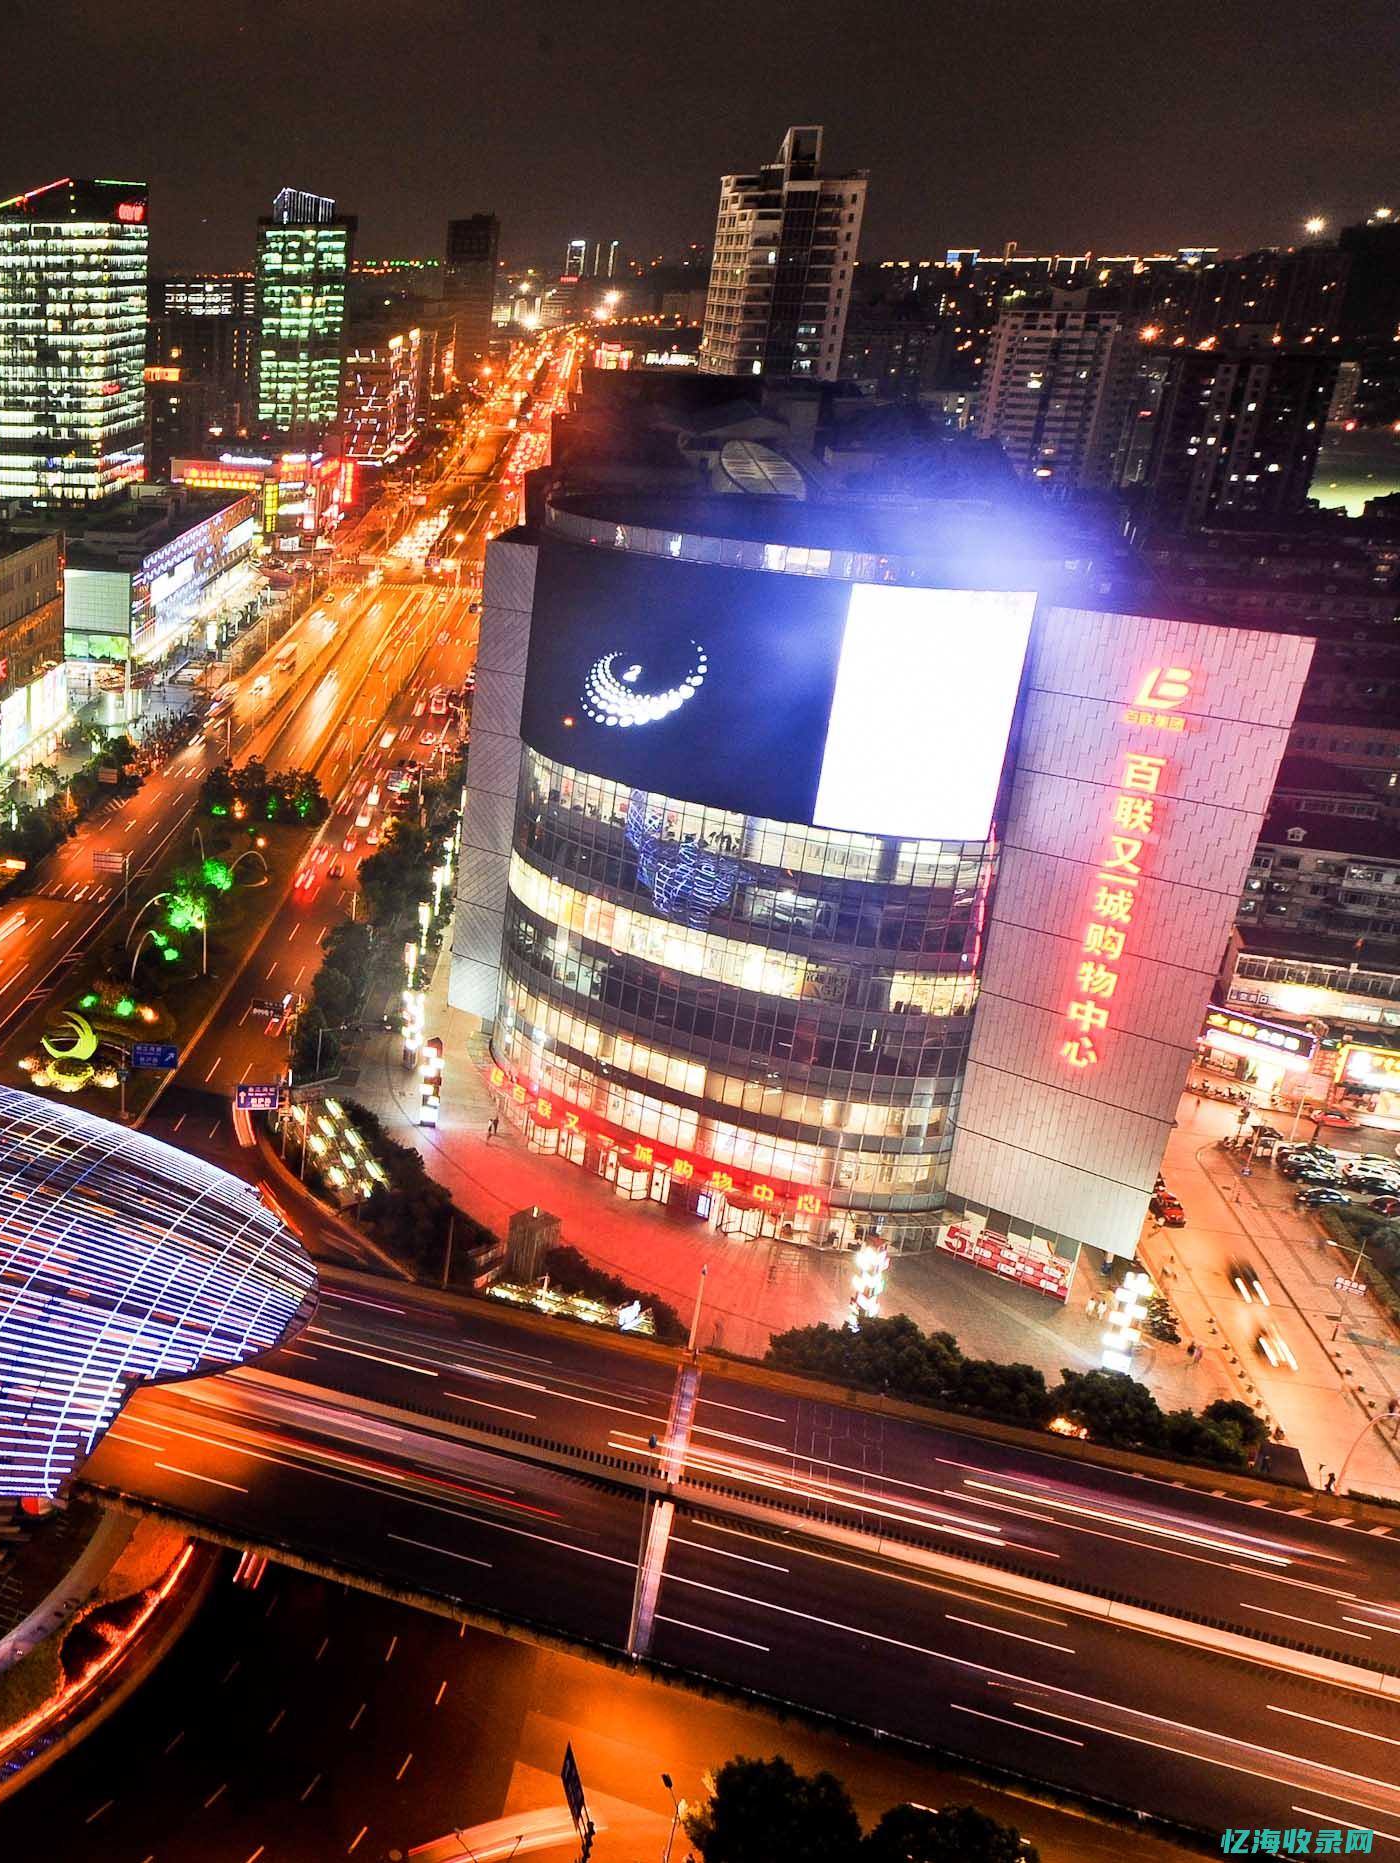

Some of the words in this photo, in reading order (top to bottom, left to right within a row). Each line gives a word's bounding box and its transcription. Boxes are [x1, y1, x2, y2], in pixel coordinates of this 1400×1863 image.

[1059, 751, 1168, 1069] 百联又一城购物中心
[512, 1082, 821, 1215] 百联又一城购物中心
